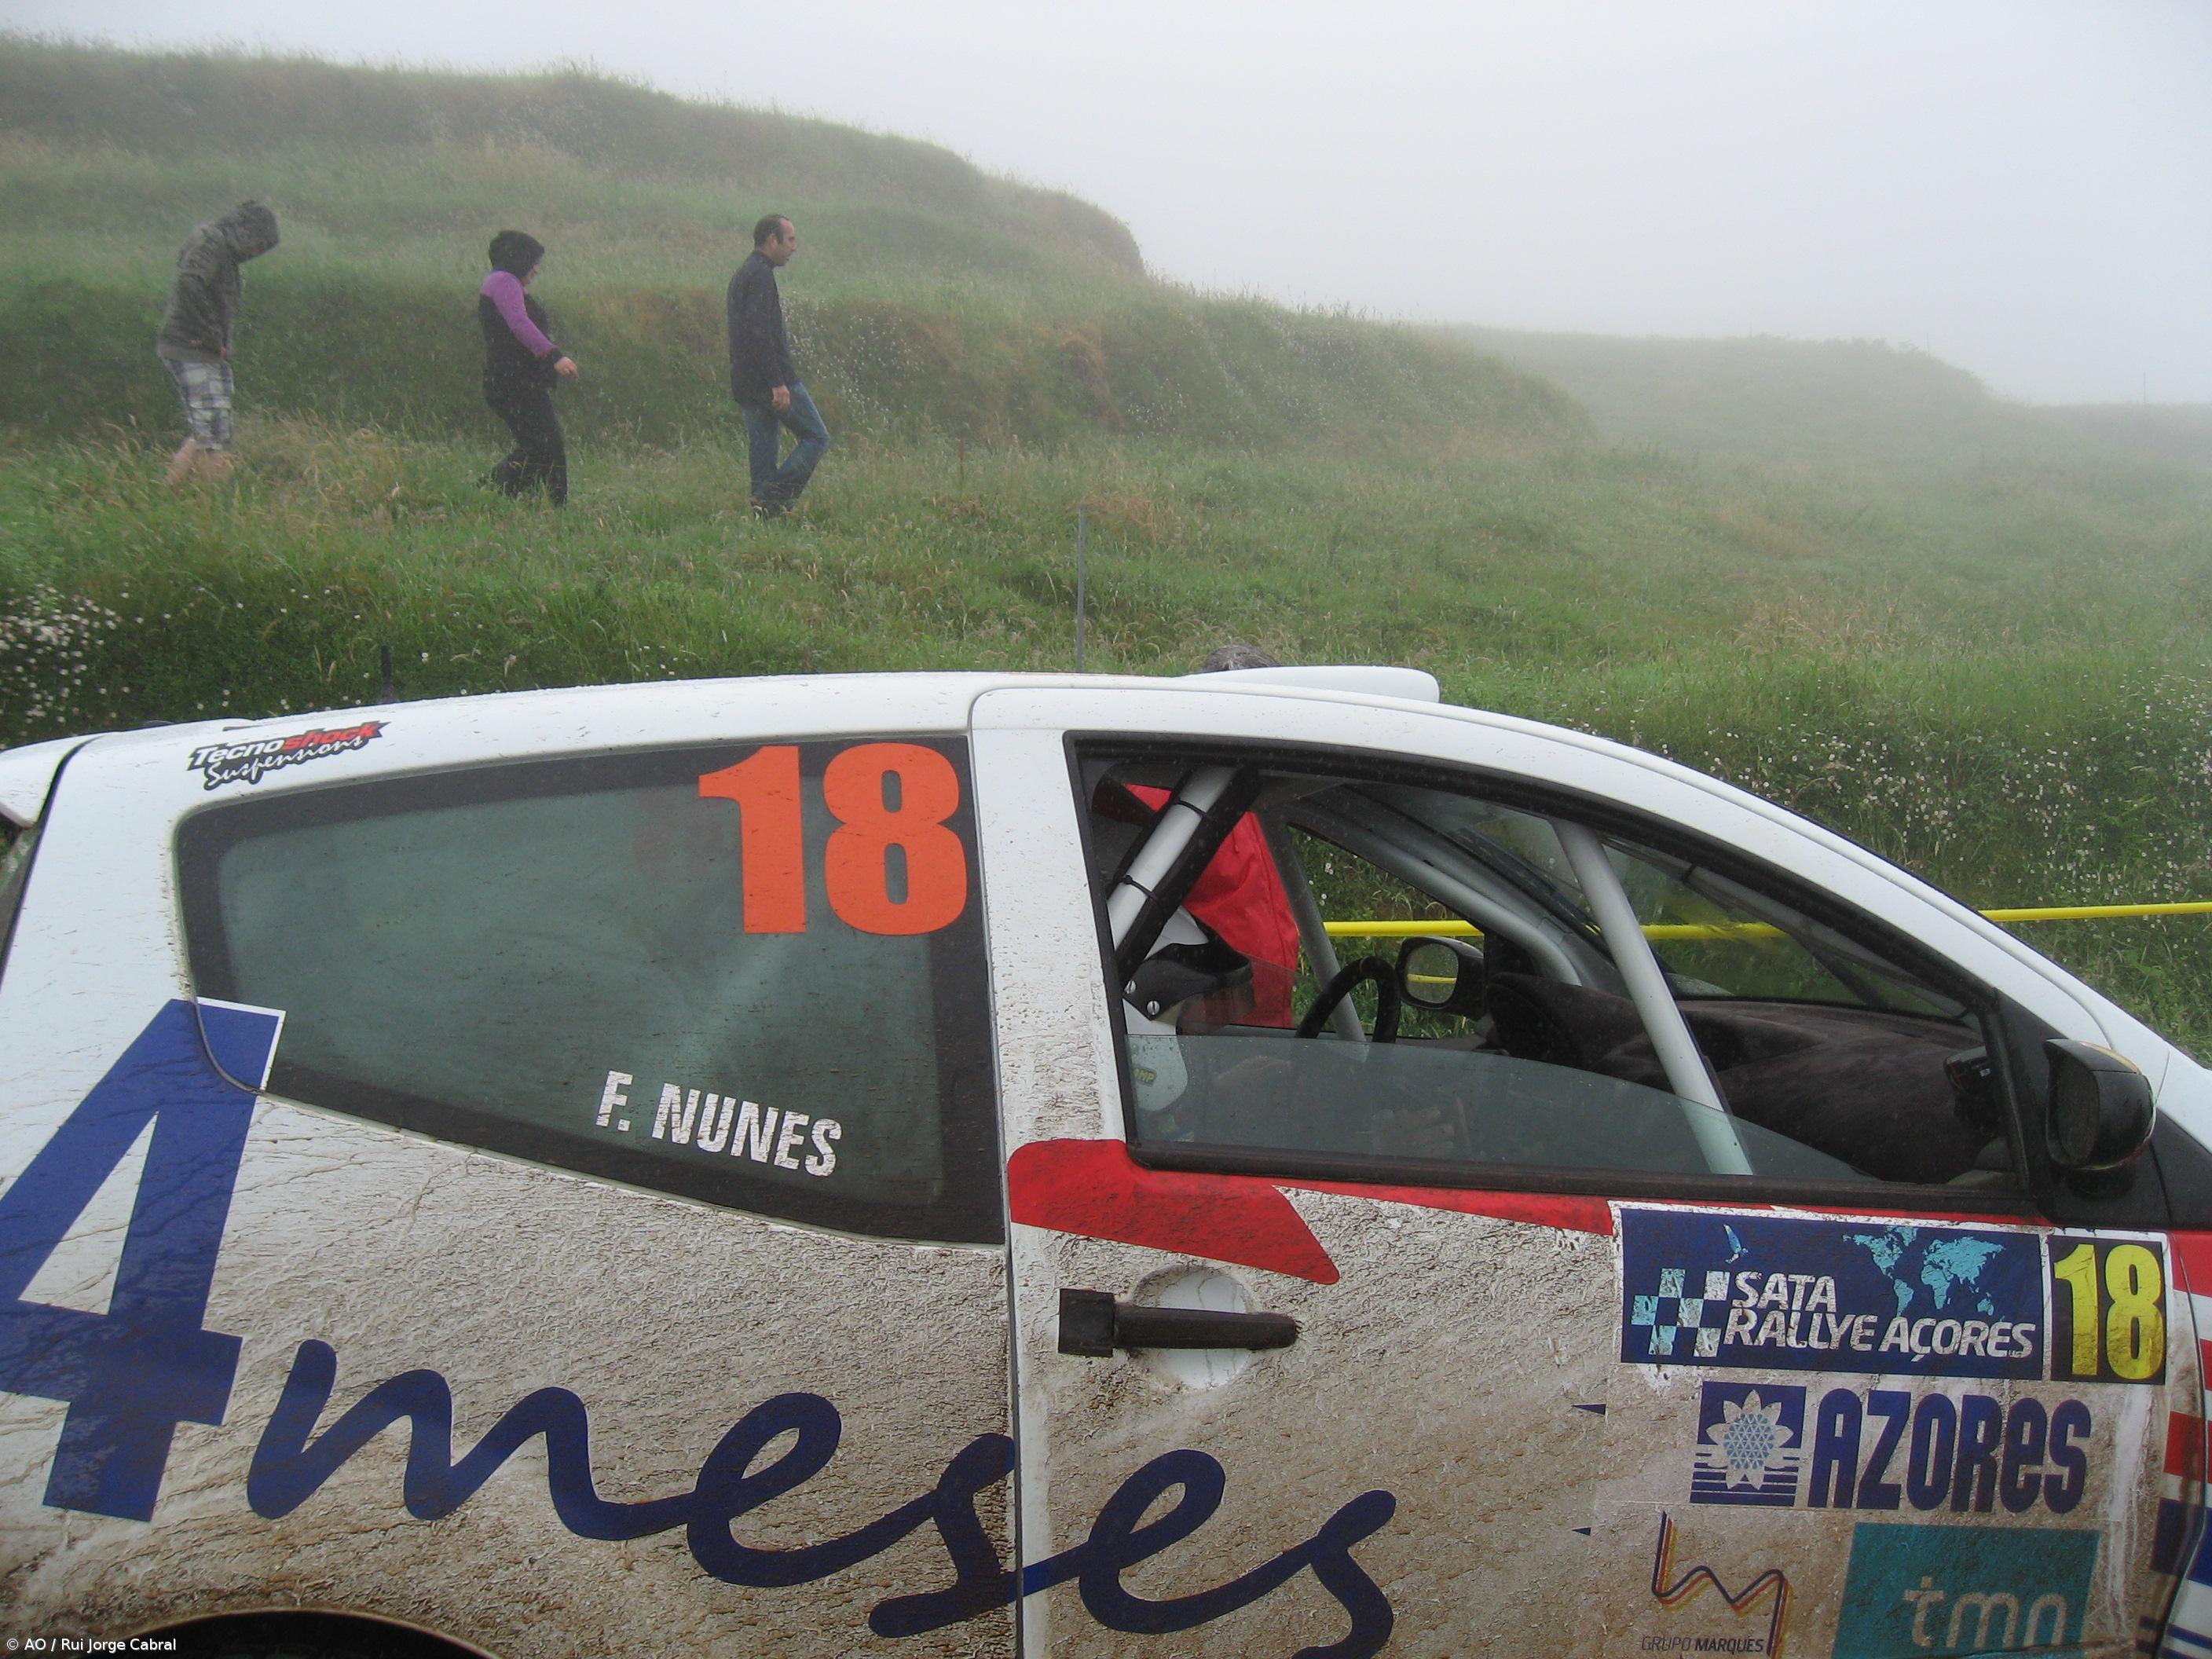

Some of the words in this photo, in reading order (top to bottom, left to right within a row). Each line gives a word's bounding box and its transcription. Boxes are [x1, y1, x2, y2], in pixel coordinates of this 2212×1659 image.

[207, 736, 363, 786] Suspensions
[698, 742, 967, 936] 18
[595, 1070, 633, 1132] F.
[651, 1083, 842, 1177] NUNES
[1732, 1271, 1837, 1313] SATA
[2053, 1243, 2165, 1380] 18
[1723, 1307, 1878, 1352] RALLYE
[1878, 1316, 2037, 1362] AÇORES
[1903, 1576, 2069, 1649] tmn
[1642, 1635, 1690, 1652] GRUPO
[1694, 1638, 1764, 1655] MARQUES
